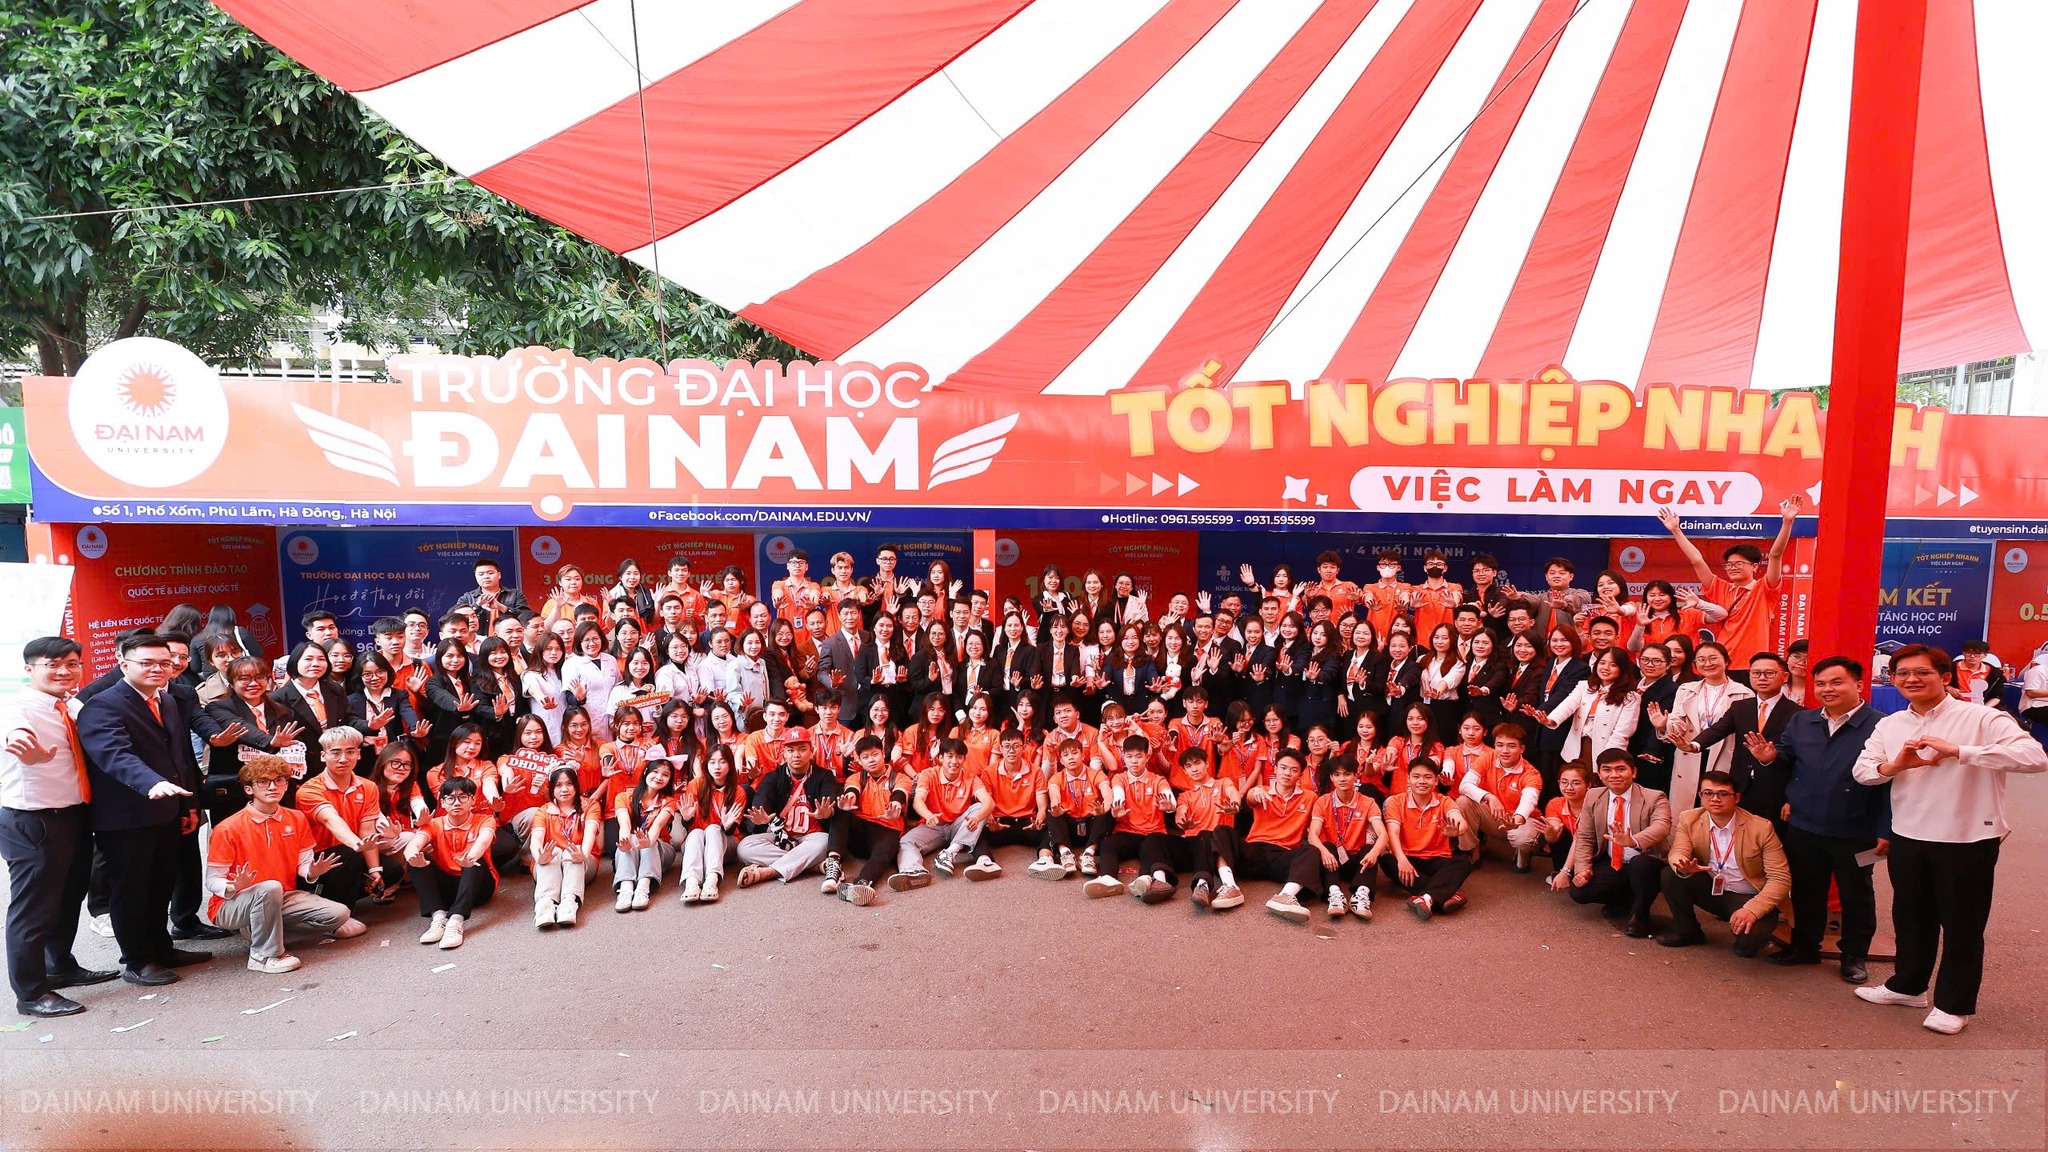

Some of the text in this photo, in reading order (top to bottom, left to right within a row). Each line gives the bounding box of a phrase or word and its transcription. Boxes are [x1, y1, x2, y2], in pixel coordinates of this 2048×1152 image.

[401, 356, 922, 418] TRƯỜNG ĐẠI HỌC
[1111, 359, 1945, 471] TỐT NGHIỆP NHAH
[94, 424, 204, 443] ĐẠI NAM
[403, 411, 919, 514] ĐẠI NAM
[1383, 470, 1733, 509] VIỆC LÀM NGAY
[102, 504, 121, 516] Số
[123, 506, 133, 518] 1,
[136, 503, 166, 516] Phố
[168, 503, 205, 518] Xốm,
[208, 504, 237, 517] Phú
[241, 505, 276, 518] Lãm,
[279, 506, 299, 518] Hà
[351, 507, 370, 518] Hà
[373, 507, 397, 520] Nội
[657, 509, 872, 522] Facebook.com/DAINAM.EDU.VN/
[1110, 513, 1158, 524] Hotline:
[1160, 514, 1234, 525] 0961.595599
[1244, 515, 1316, 525] 0931.595599
[1357, 546, 1366, 555] 4
[115, 564, 167, 577] CHƯƠNG
[170, 563, 202, 576] TRÌNH
[204, 562, 226, 575] ĐÀO
[300, 570, 341, 579] TRƯỜNG
[344, 572, 361, 581] ĐẠI
[364, 572, 385, 581] HỌC
[387, 572, 405, 581] ĐẠI
[543, 575, 552, 585] 3
[127, 580, 239, 599] QUỐC TẾ & LIÊN KẾT QUỐC TẾ
[370, 587, 401, 608] thay
[1905, 580, 1952, 607] KẾT
[1779, 594, 1789, 610] ĐẠI
[88, 621, 100, 631] HỆ
[101, 618, 117, 628] LIÊN
[119, 617, 132, 626] KẾT
[133, 615, 155, 625] QUỐC
[1796, 594, 1807, 636] ĐẠI NAM
[1911, 612, 1936, 624] HỌC
[1938, 610, 1958, 622] PHÍ
[1779, 613, 1787, 636] NAM
[1883, 624, 1915, 635] KHÓA
[1918, 625, 1942, 637] HỌC
